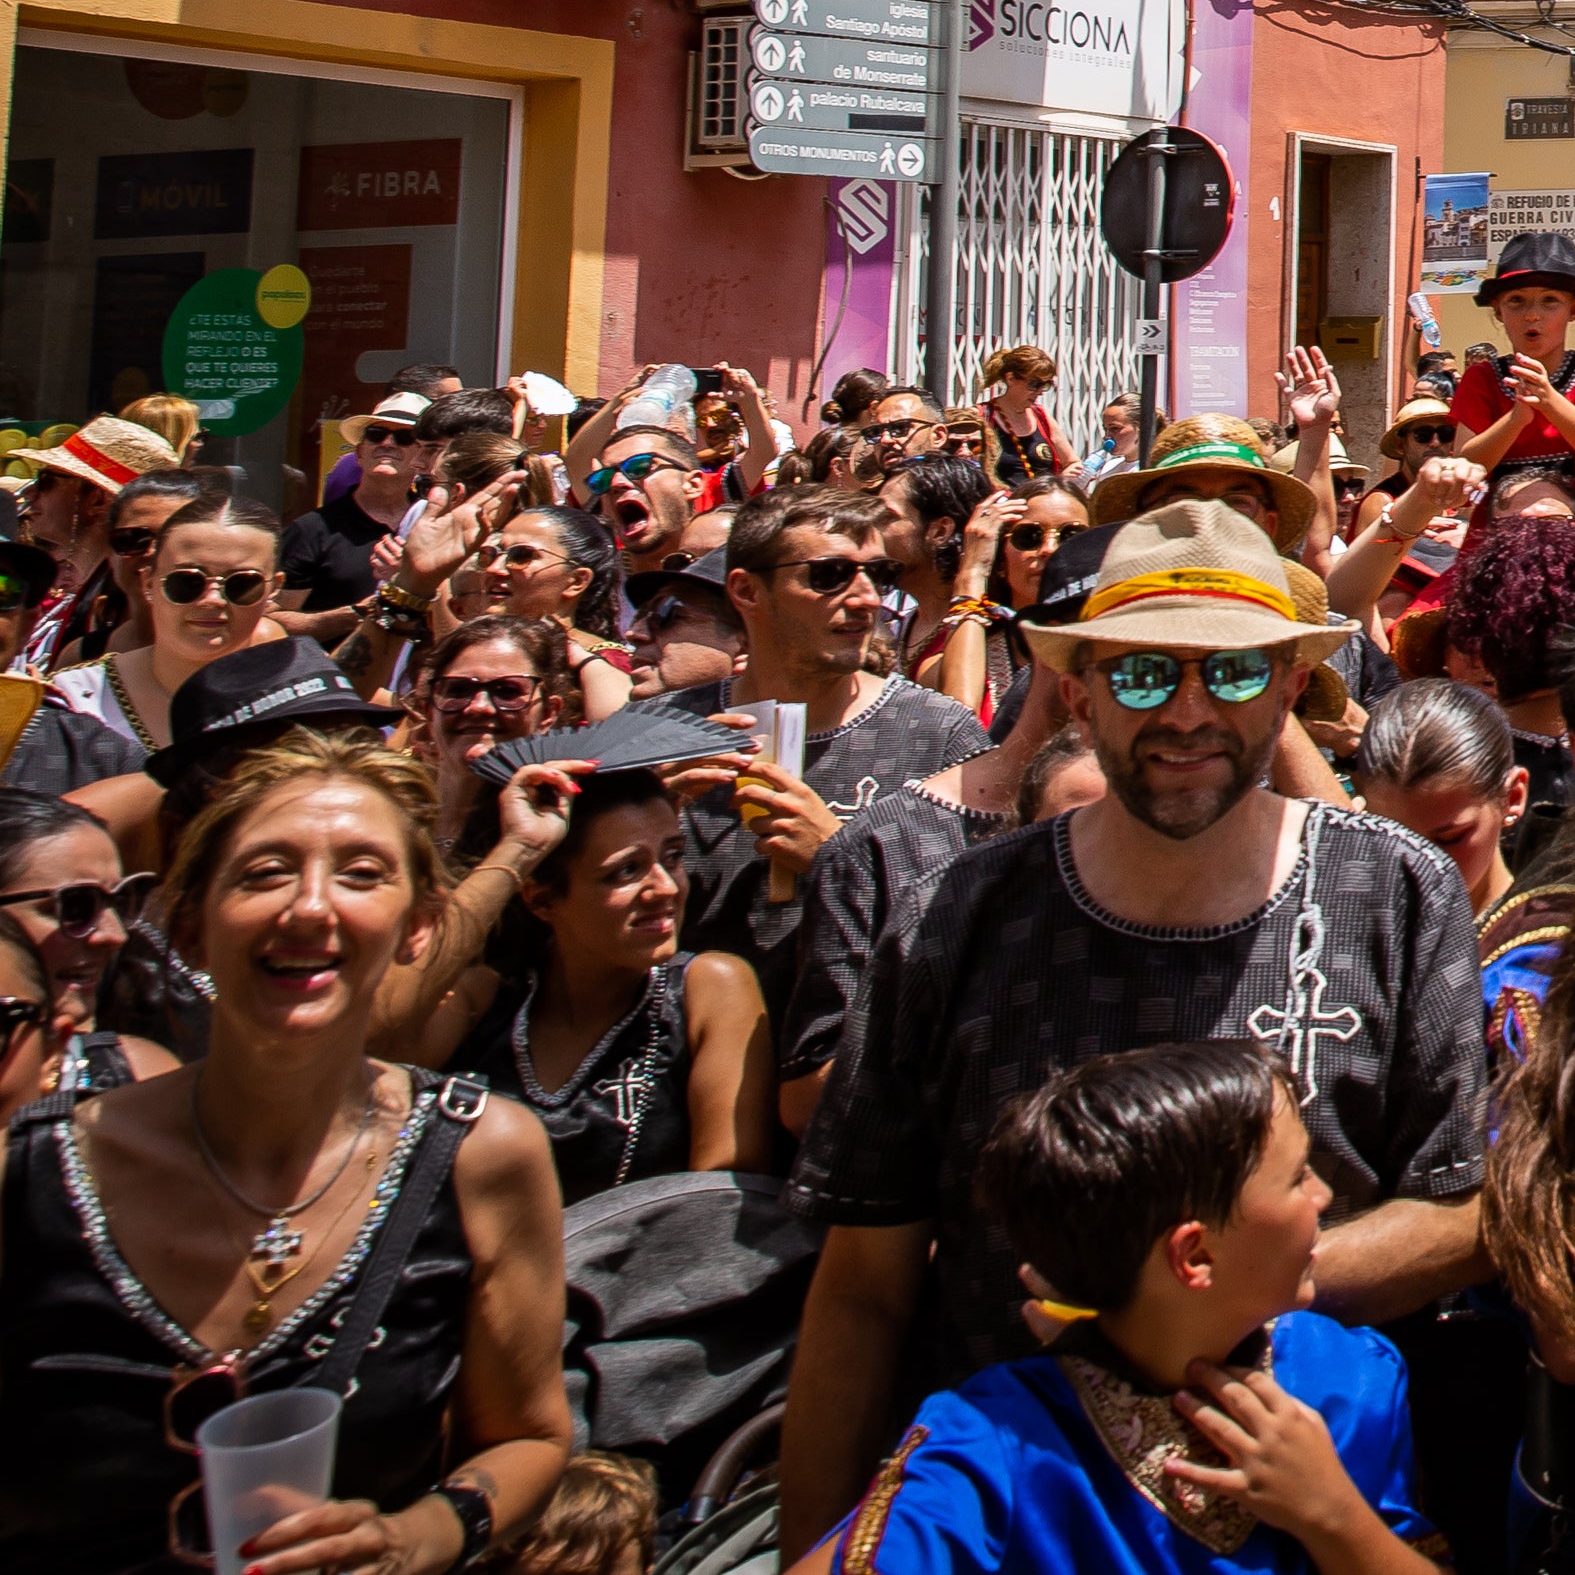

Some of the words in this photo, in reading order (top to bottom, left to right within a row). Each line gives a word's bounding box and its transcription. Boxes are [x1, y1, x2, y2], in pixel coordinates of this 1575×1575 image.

[889, 2, 928, 19] iglesia
[825, 15, 881, 34] Santiago
[881, 20, 928, 39] Apóstol
[867, 50, 927, 66] santuario
[1000, 39, 1065, 60] soluciones
[1069, 51, 1131, 69] integrales
[833, 65, 852, 79] de
[853, 66, 927, 86] Monserrate
[810, 93, 858, 109] palacio
[859, 94, 926, 113] Rubalcava
[1511, 123, 1570, 135] TRIANA
[759, 142, 798, 157] OTROS
[799, 146, 878, 163] MONUMENTOS
[357, 170, 442, 198] FIBRA
[140, 177, 229, 211] MÓVIL
[1507, 195, 1553, 209] REFUGIO
[1556, 195, 1571, 208] DE
[1489, 211, 1544, 225] GUERRA
[187, 330, 243, 342] MIRANDO
[245, 330, 261, 342] EN
[263, 330, 278, 342] EL
[186, 345, 240, 357] REFLEJO
[241, 346, 251, 357] O
[253, 346, 268, 357] ES
[185, 362, 211, 374] QUE
[214, 362, 228, 373] TE
[229, 362, 279, 374] QUIERES
[184, 378, 224, 389] HACER
